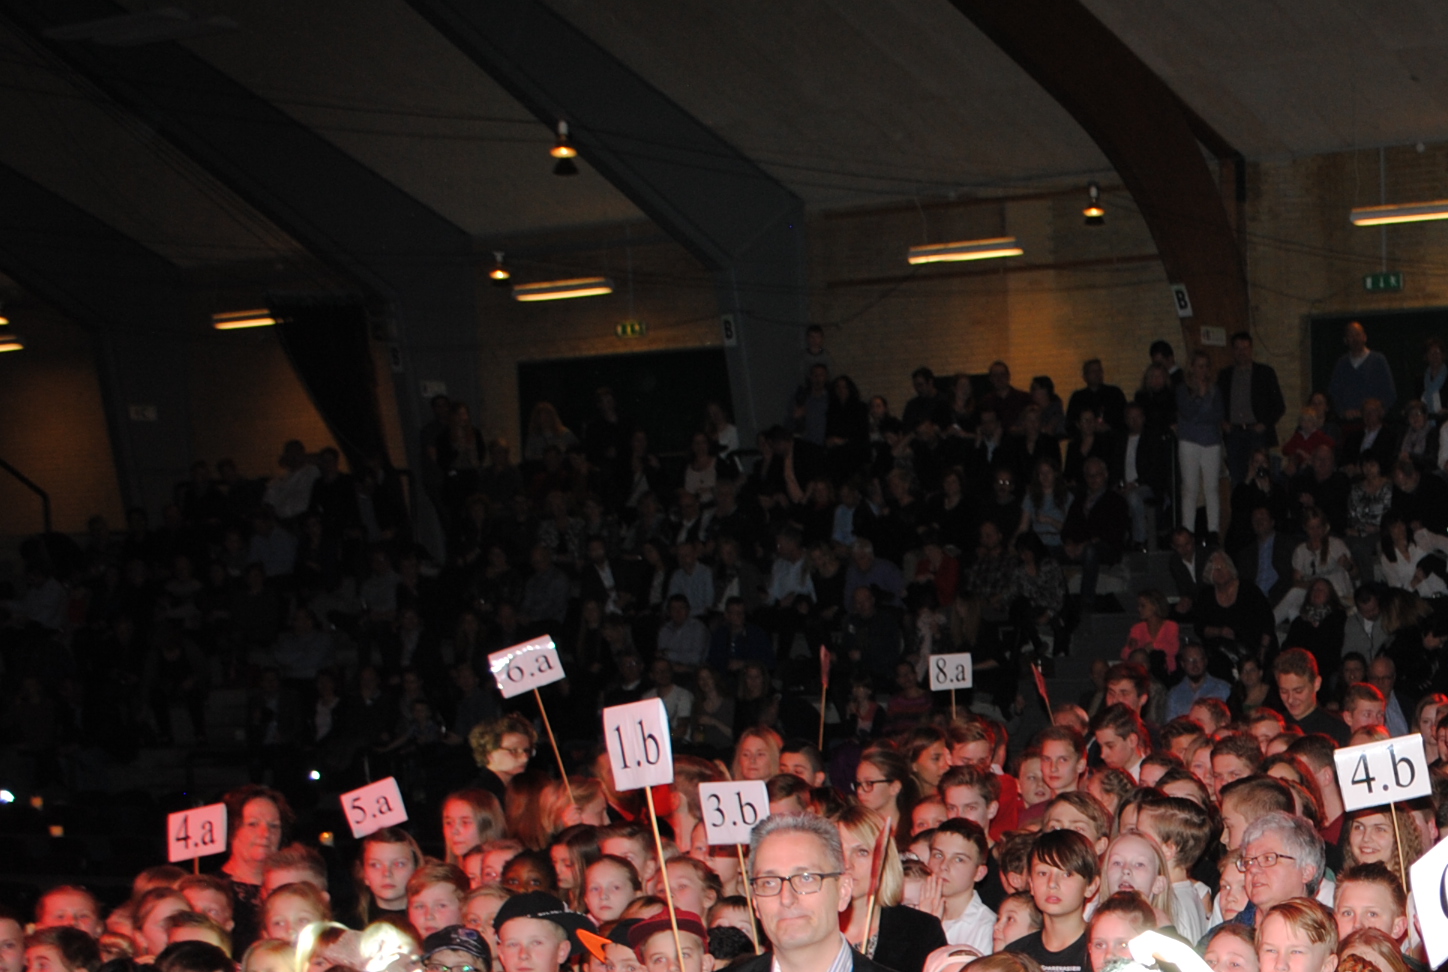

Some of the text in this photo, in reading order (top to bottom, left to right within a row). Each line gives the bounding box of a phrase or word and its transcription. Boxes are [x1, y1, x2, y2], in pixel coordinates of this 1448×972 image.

[1175, 290, 1188, 309] B
[723, 320, 734, 339] B
[507, 655, 555, 684] 6.a
[936, 658, 966, 684] 8.a
[614, 720, 661, 771] 1.b
[1349, 744, 1416, 795] 4.b
[351, 793, 395, 825] 5.a
[707, 791, 758, 829] 3.b
[175, 814, 216, 849] 4.a
